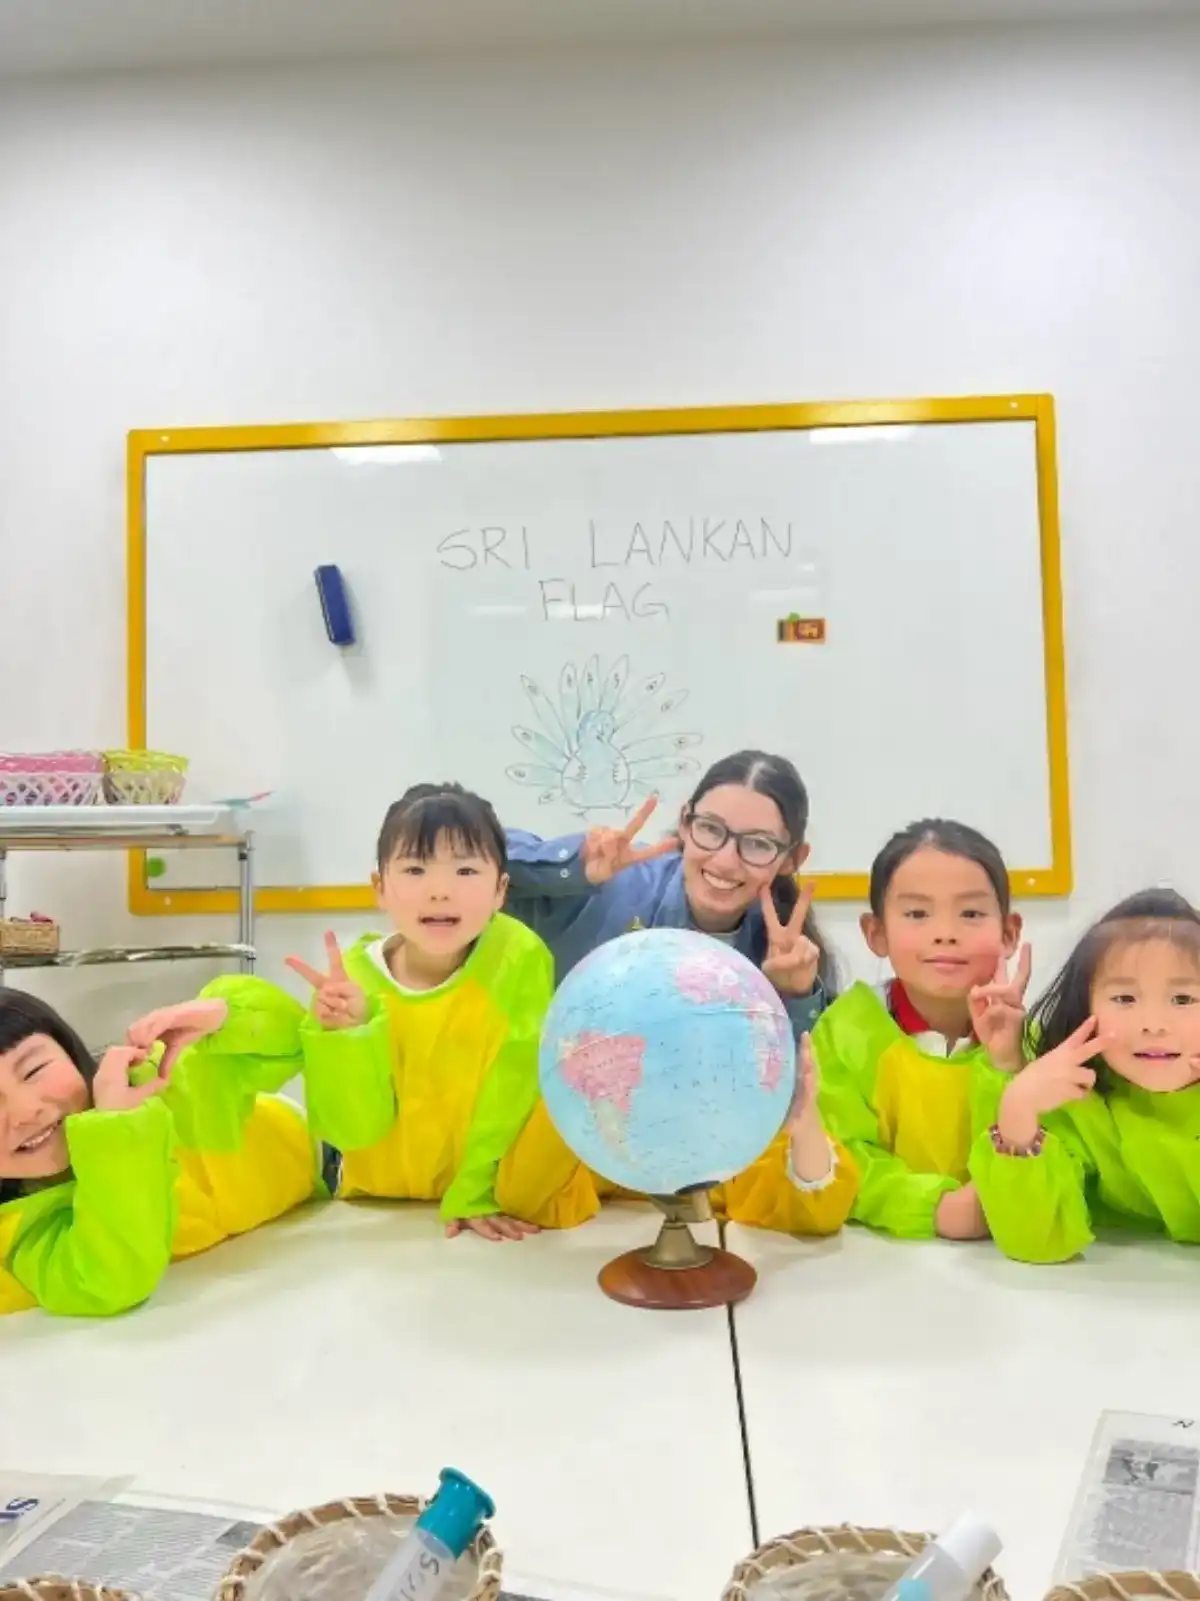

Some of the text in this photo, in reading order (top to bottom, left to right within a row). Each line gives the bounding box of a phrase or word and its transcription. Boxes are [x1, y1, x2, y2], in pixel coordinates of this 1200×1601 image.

[436, 517, 792, 571] SRI LANKAN
[538, 578, 670, 622] FLAG
